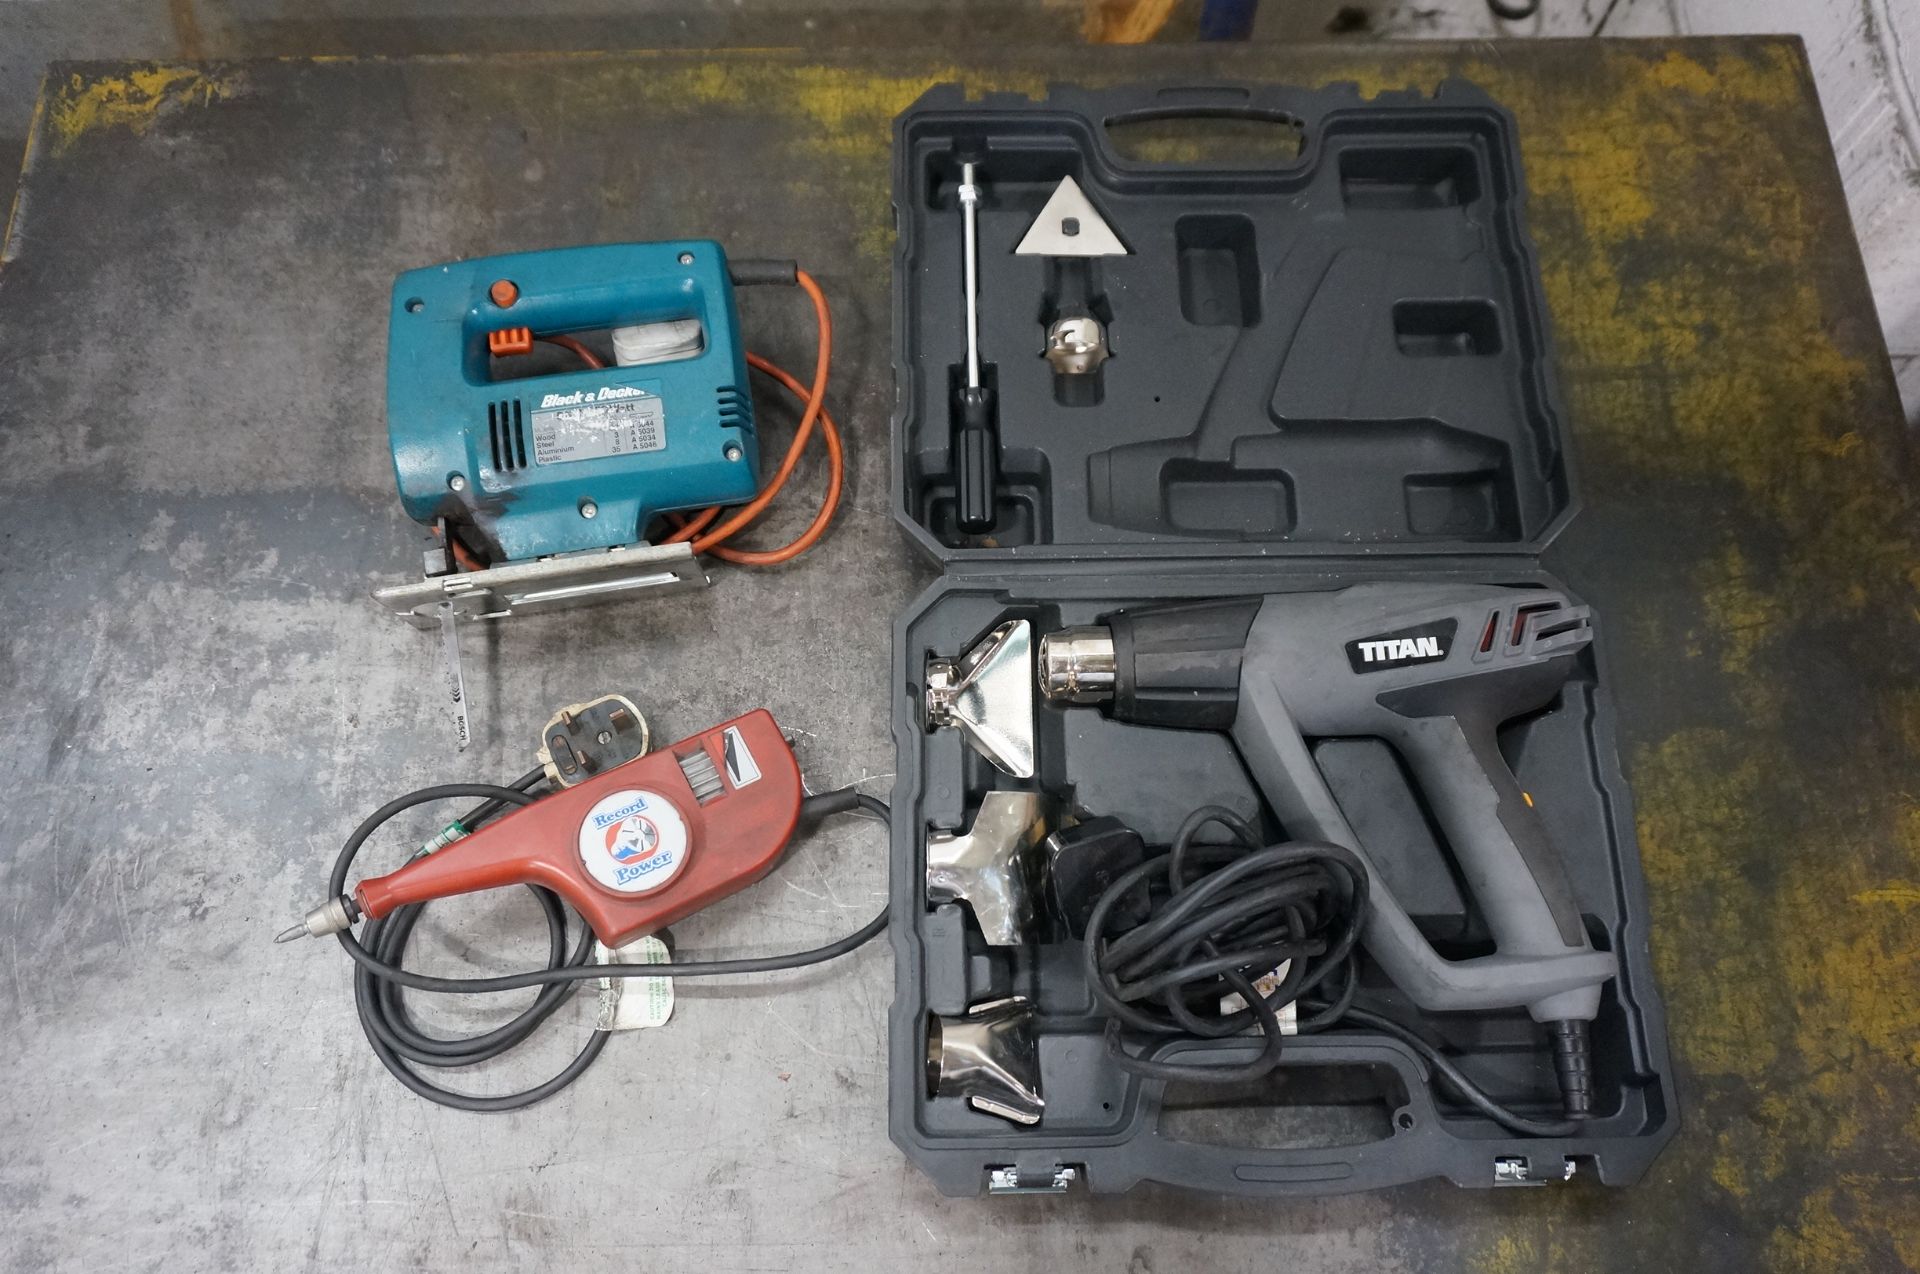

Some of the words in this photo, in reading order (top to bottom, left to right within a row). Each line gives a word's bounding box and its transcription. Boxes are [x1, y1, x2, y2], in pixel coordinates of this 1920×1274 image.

[541, 391, 585, 408] Black
[584, 392, 596, 402] &
[597, 387, 645, 400] Decke
[535, 434, 556, 442] Wood
[536, 441, 555, 449] Steel
[537, 446, 575, 456] Aluminium
[538, 455, 562, 463] Plastic
[1358, 636, 1439, 662] TITAN
[457, 715, 467, 741] BOSCH
[593, 796, 647, 828] Record
[614, 852, 671, 883] Power
